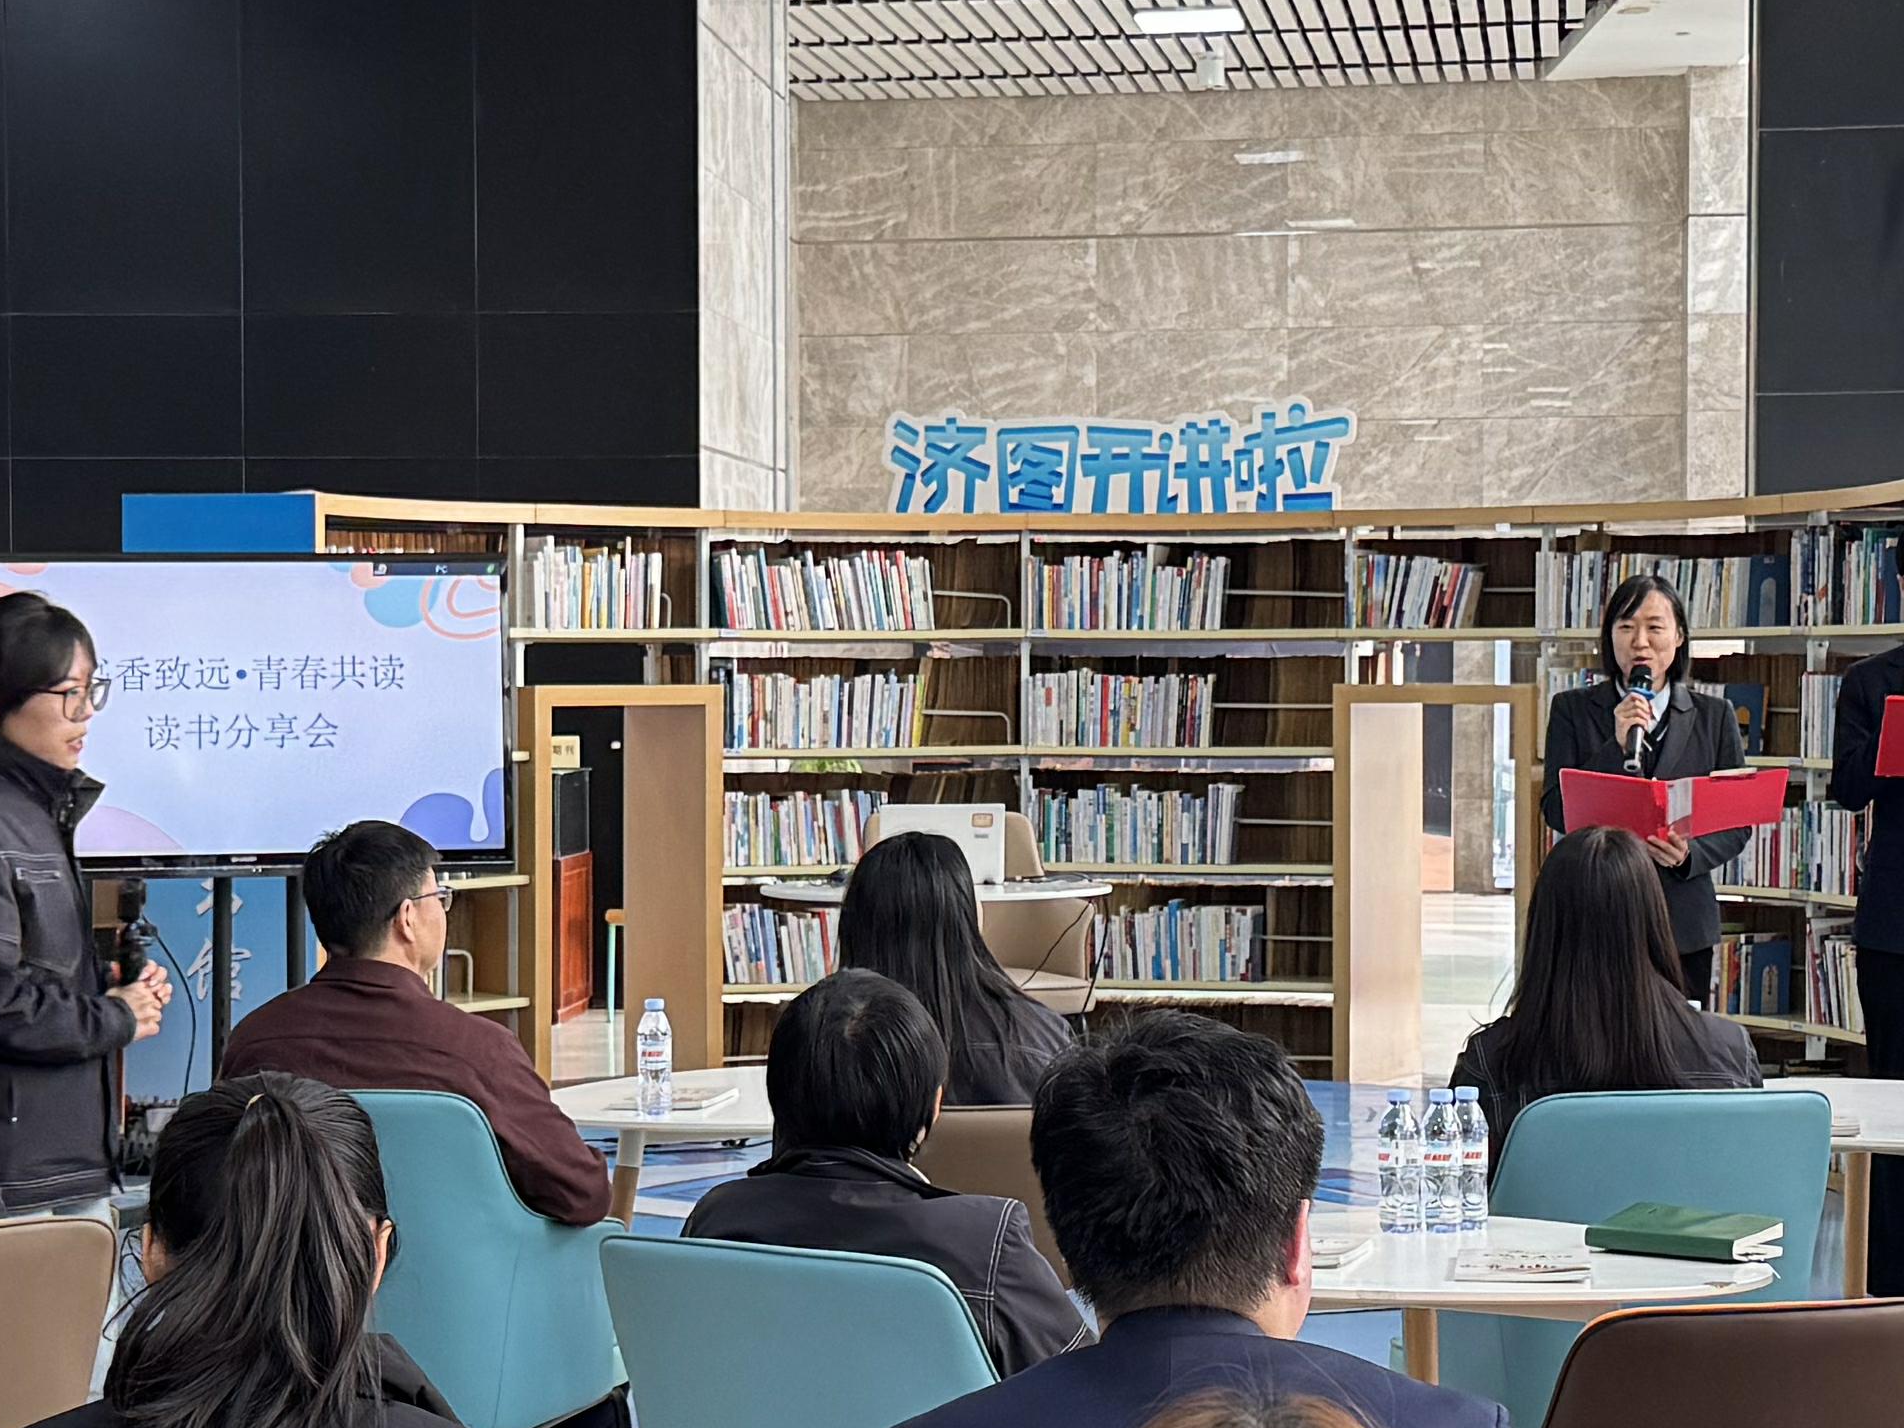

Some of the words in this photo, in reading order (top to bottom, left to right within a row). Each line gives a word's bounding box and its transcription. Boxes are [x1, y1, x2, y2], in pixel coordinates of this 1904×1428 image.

[891, 403, 1349, 513] 济图开讲啦
[144, 711, 339, 751] 读书分享会
